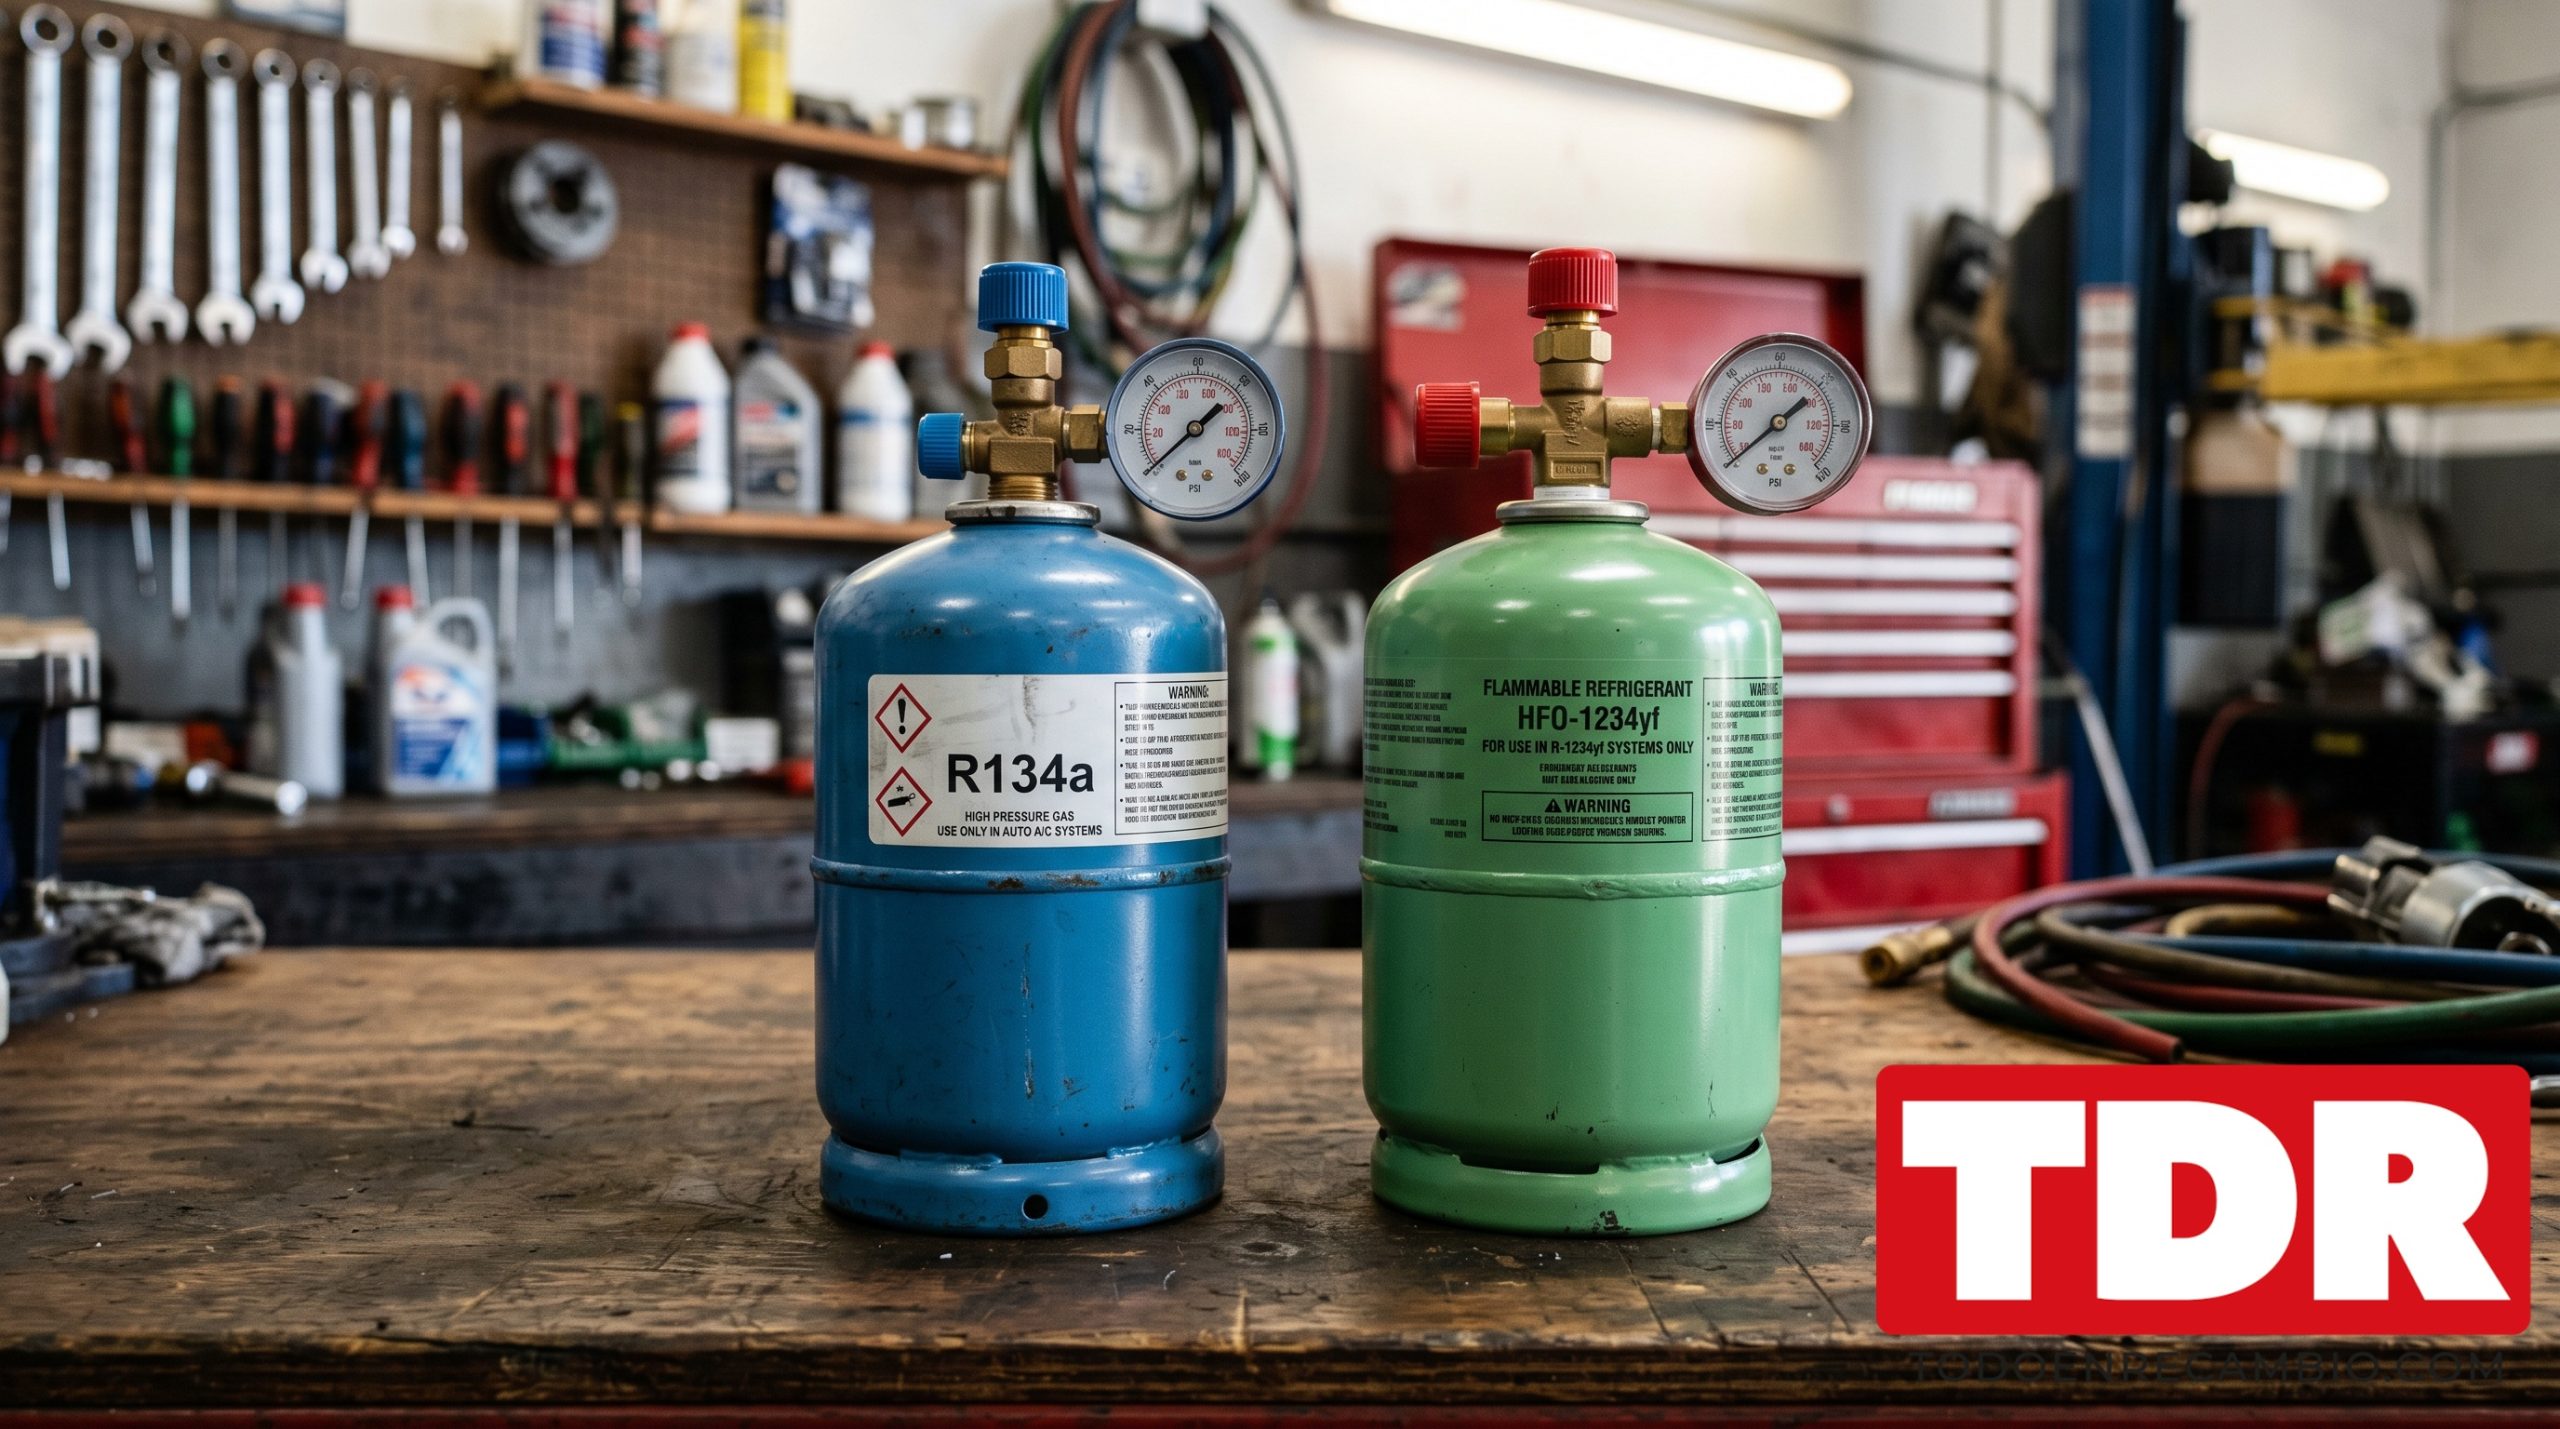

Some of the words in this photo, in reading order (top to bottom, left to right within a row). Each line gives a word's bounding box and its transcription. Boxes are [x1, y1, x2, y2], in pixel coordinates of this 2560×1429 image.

[1152, 427, 1164, 438] 20
[1188, 484, 1201, 493] PSI
[1483, 679, 1581, 697] FLAMMABLE
[1586, 680, 1694, 698] REFRIGERANT
[1518, 705, 1660, 736] HFO-1234yf
[1482, 740, 1505, 754] FOR
[1508, 740, 1532, 754] USE
[1535, 740, 1548, 754] IN
[1551, 740, 1604, 756] R-1234yf
[1607, 740, 1663, 754] SYSTEMS
[1666, 740, 1694, 754] ONLY
[948, 753, 1094, 794] R134a
[1564, 798, 1630, 813] WARNING
[964, 811, 990, 822] HIGH
[993, 811, 1049, 822] PRESSURE
[1052, 811, 1074, 822] GAS
[937, 826, 958, 837] USE
[958, 826, 988, 837] ONLY
[990, 826, 999, 837] IN
[1002, 826, 1032, 837] AUTO
[1034, 826, 1052, 837] A/C
[1054, 826, 1102, 837] SYSTEMS
